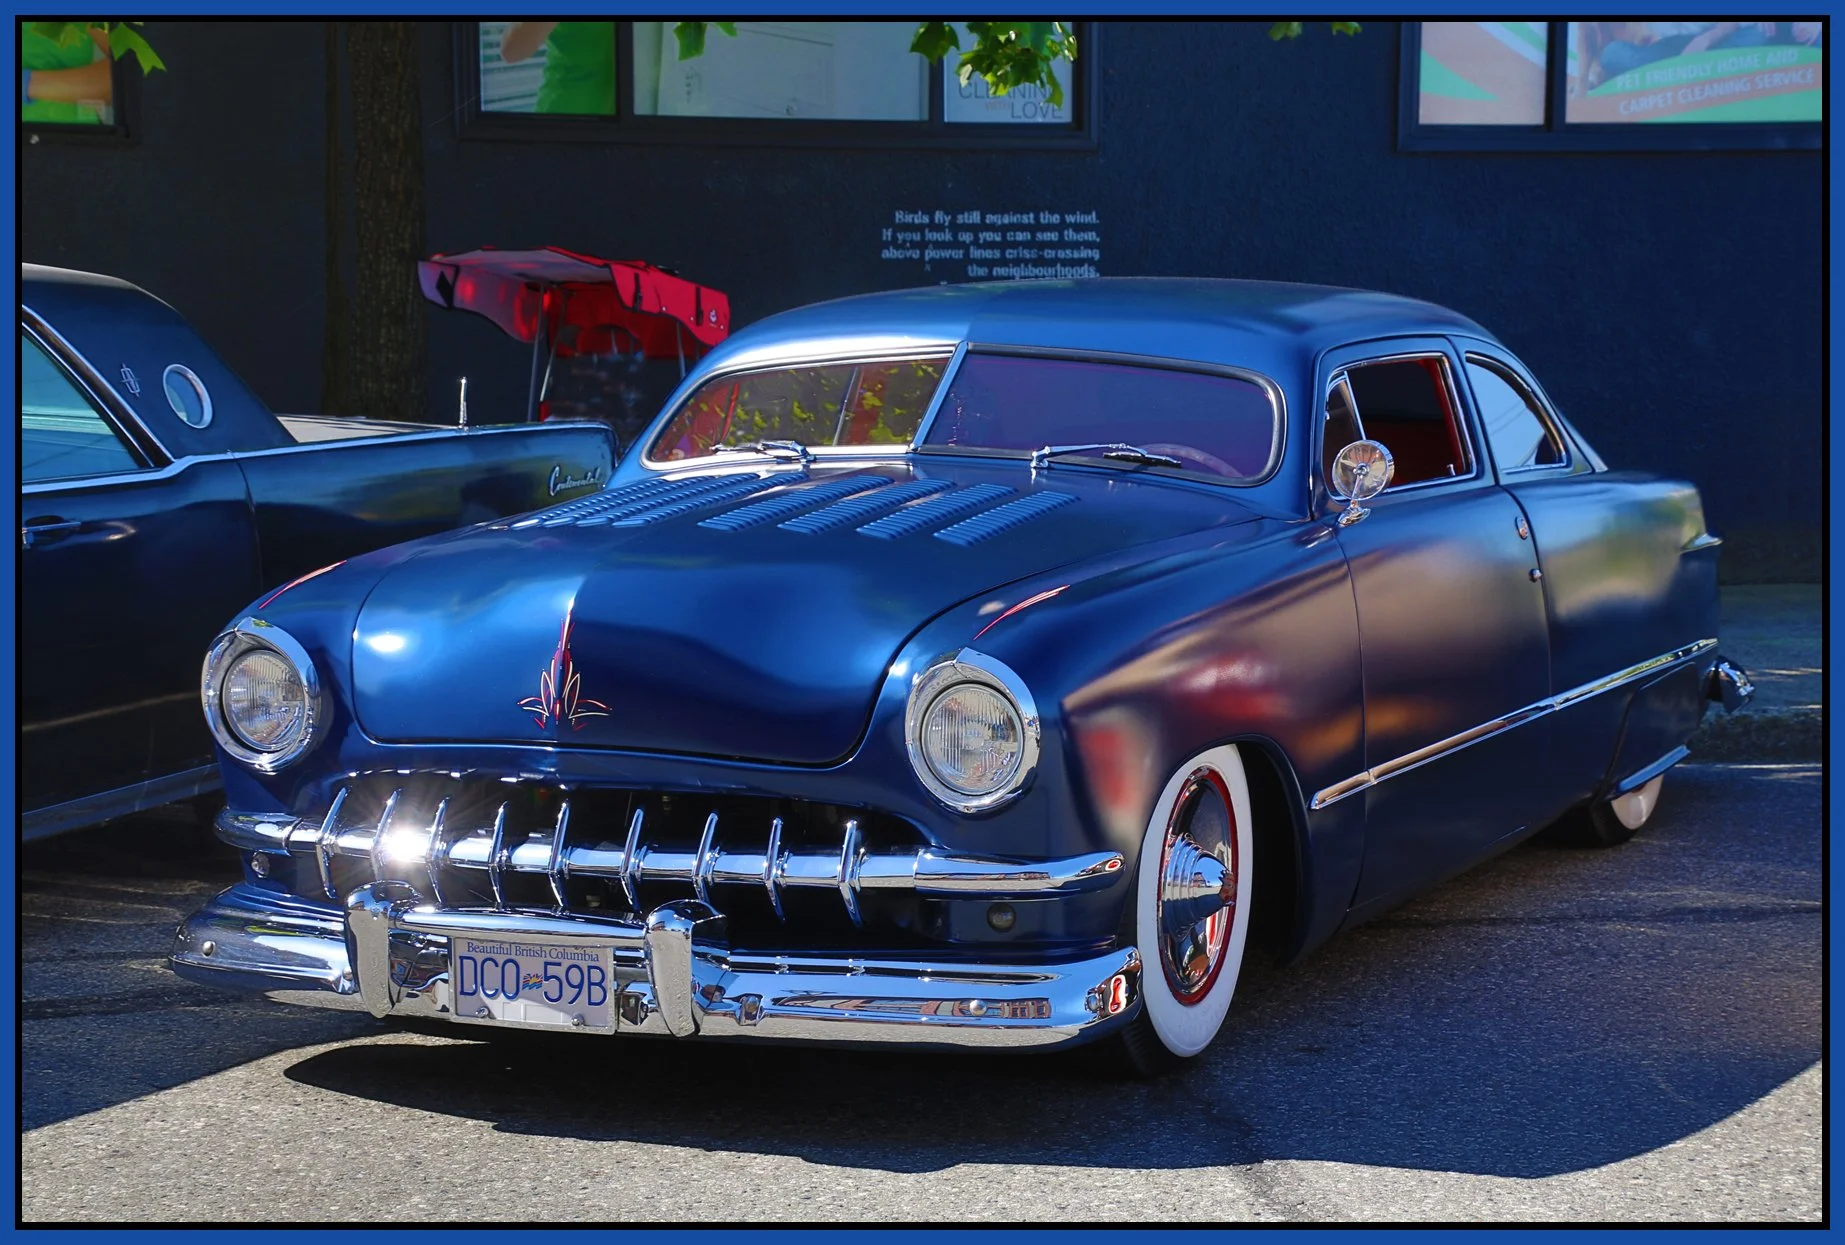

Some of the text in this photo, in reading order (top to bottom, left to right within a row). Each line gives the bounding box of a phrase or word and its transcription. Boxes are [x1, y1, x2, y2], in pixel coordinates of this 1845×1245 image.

[1617, 48, 1798, 89] PET FRIENDLY HOME AND
[1619, 68, 1815, 115] CARPET CLEANING SERVICE
[1011, 101, 1063, 119] LOVE
[895, 210, 1100, 226] Birds fly still against the wind.
[882, 228, 1100, 244] If you look up you can see them,
[881, 245, 1100, 261] above power lines criss-crossing
[967, 263, 1100, 279] the neighbourhoods.
[467, 941, 600, 962] Beautiful British Columbia
[543, 961, 608, 1007] 59B
